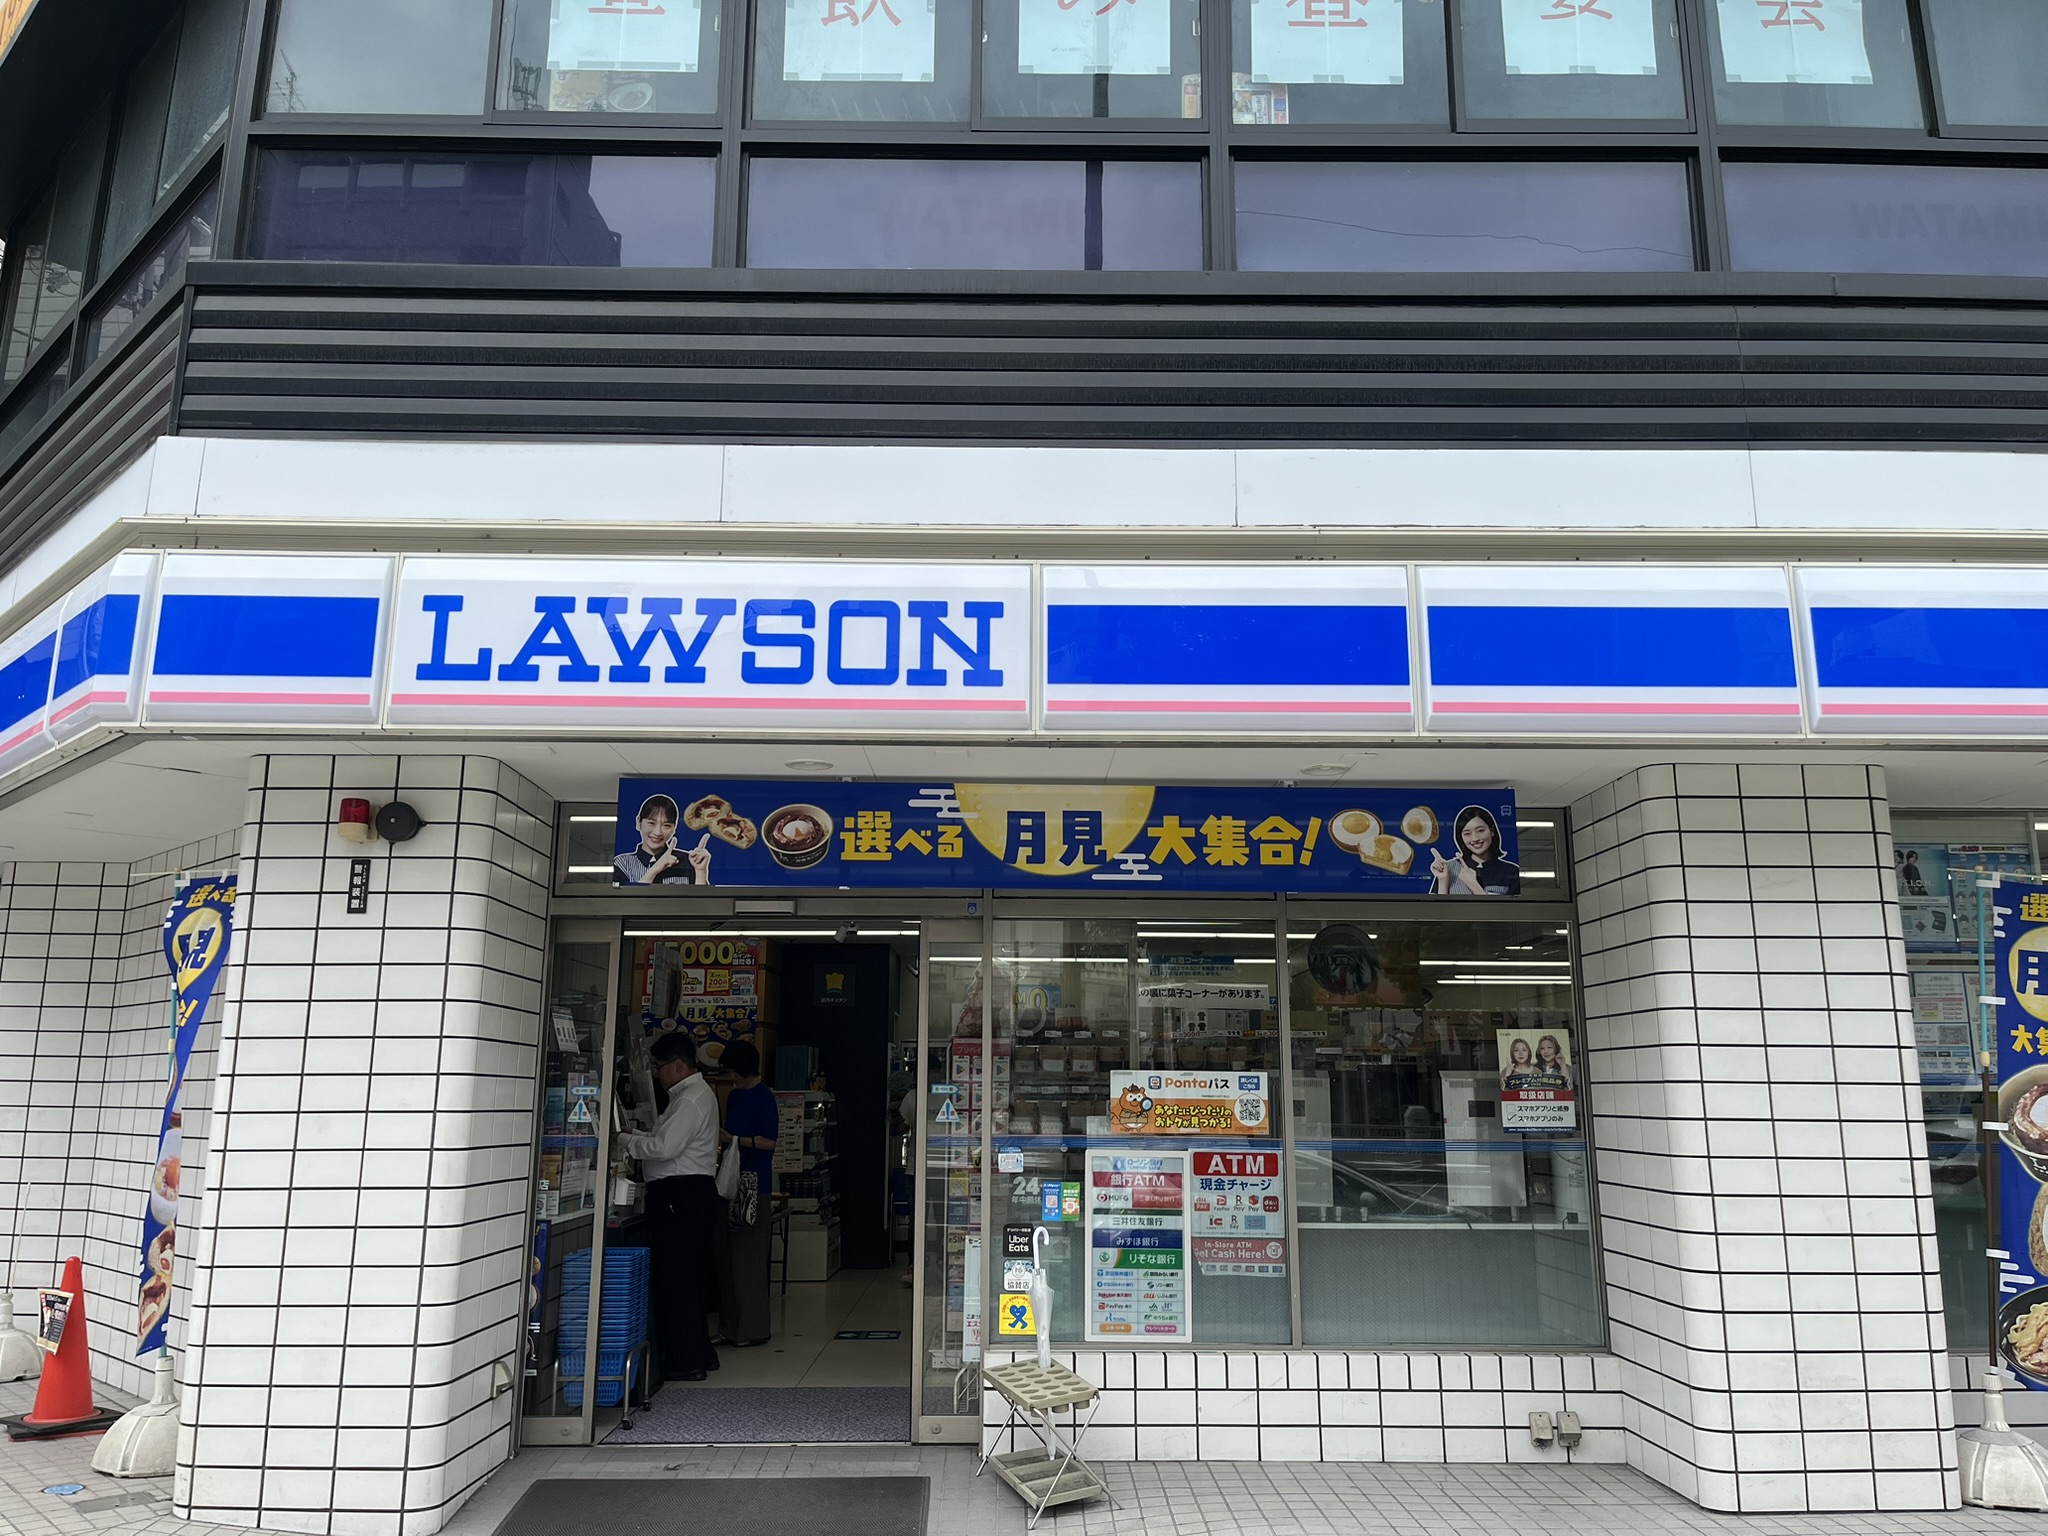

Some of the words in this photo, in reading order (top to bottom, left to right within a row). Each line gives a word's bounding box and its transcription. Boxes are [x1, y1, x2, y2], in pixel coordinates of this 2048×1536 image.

[416, 595, 1004, 685] LAWSON
[840, 811, 963, 861] 選べる
[1003, 809, 1107, 866] 月見
[1147, 815, 1322, 866] 大集合!
[1165, 1078, 1230, 1089] Pontaパス
[1154, 1104, 1233, 1116] あなたにぴったりの
[1154, 1116, 1231, 1128] おトクが見つかる!
[1208, 1155, 1264, 1175] ATM
[1013, 1176, 1040, 1195] 24
[1111, 1174, 1165, 1186] 銀行ATM
[1200, 1178, 1272, 1191] 現金チャージ
[1112, 1217, 1163, 1226] 三井住友銀行
[1008, 1235, 1029, 1243] Uber
[1116, 1237, 1159, 1247] みずほ銀行
[1009, 1244, 1029, 1252] Eats
[1211, 1248, 1239, 1258] Cash
[1241, 1249, 1265, 1258] Here!
[1129, 1254, 1176, 1265] りそな銀行
